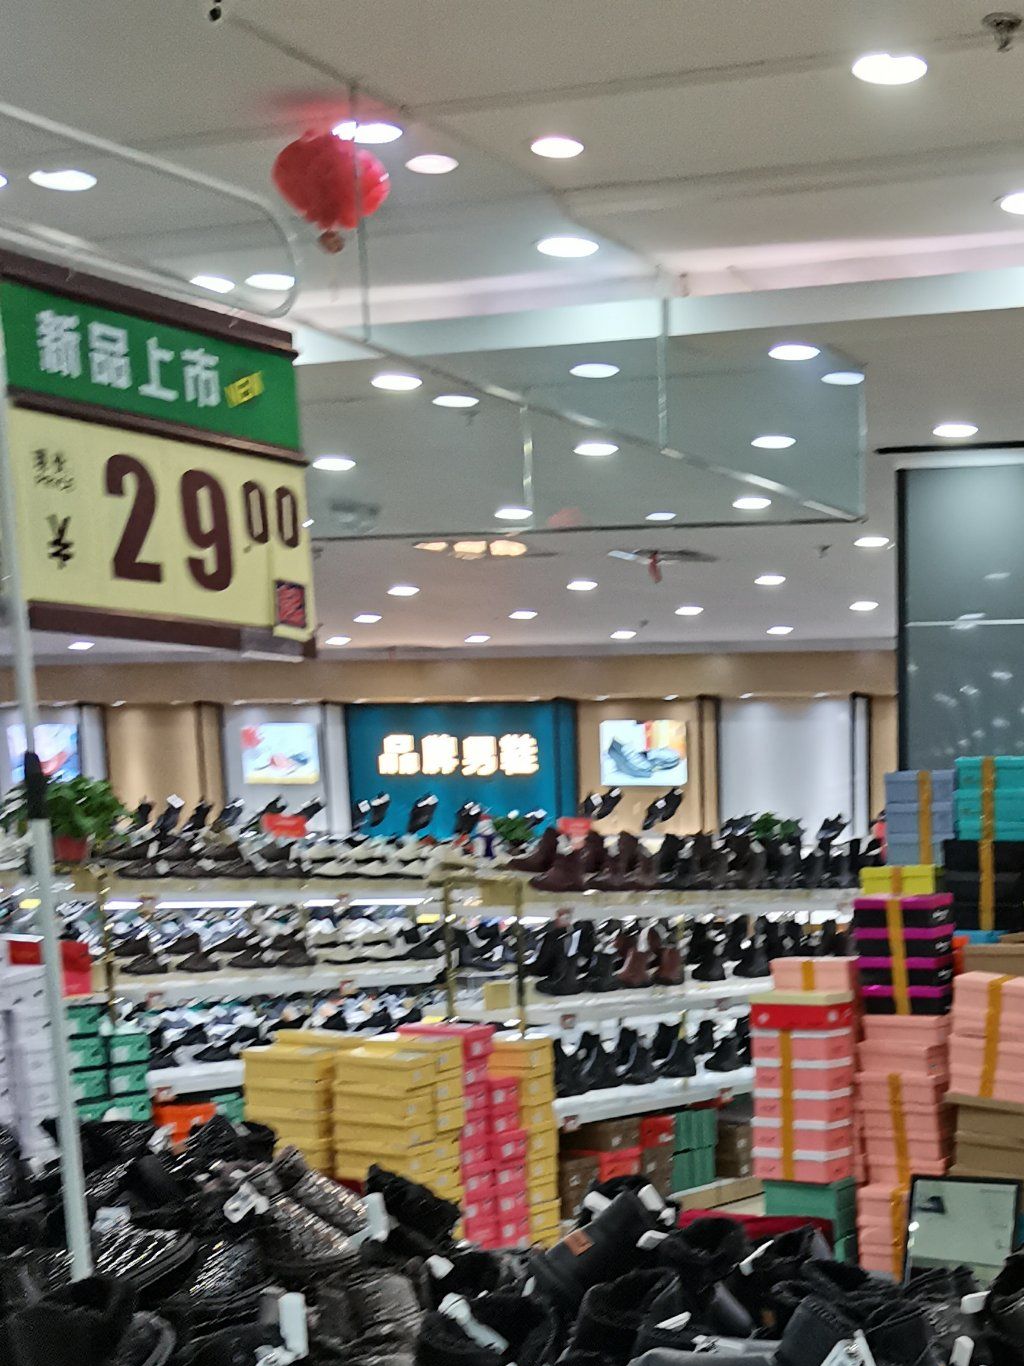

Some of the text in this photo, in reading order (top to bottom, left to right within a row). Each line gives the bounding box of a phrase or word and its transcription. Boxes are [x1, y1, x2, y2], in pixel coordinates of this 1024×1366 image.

[36, 310, 221, 407] 新品上市
[378, 733, 540, 776] 品牌男鞋
